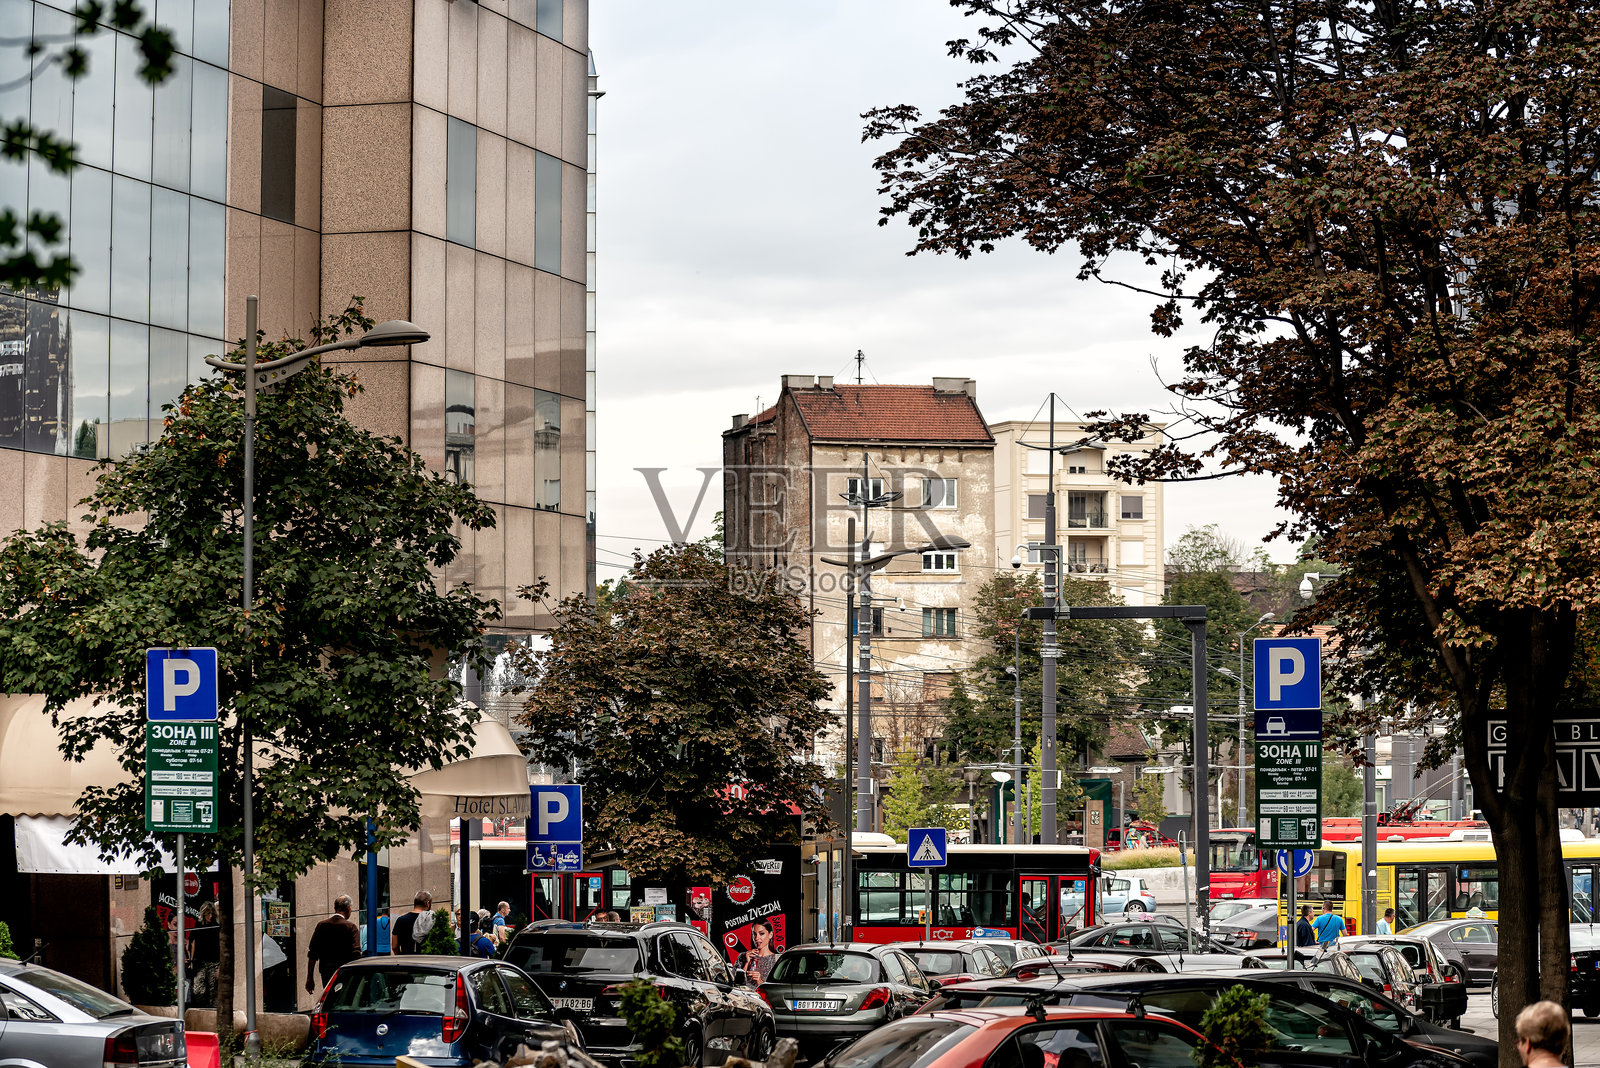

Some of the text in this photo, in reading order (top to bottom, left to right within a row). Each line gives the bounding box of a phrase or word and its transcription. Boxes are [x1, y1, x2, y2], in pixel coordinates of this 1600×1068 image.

[163, 658, 200, 711] P
[1269, 647, 1305, 701] P
[152, 725, 214, 740] ЗОНА III
[1260, 744, 1318, 758] ЗОНА III
[455, 795, 494, 814] Hotel
[538, 791, 569, 835] P
